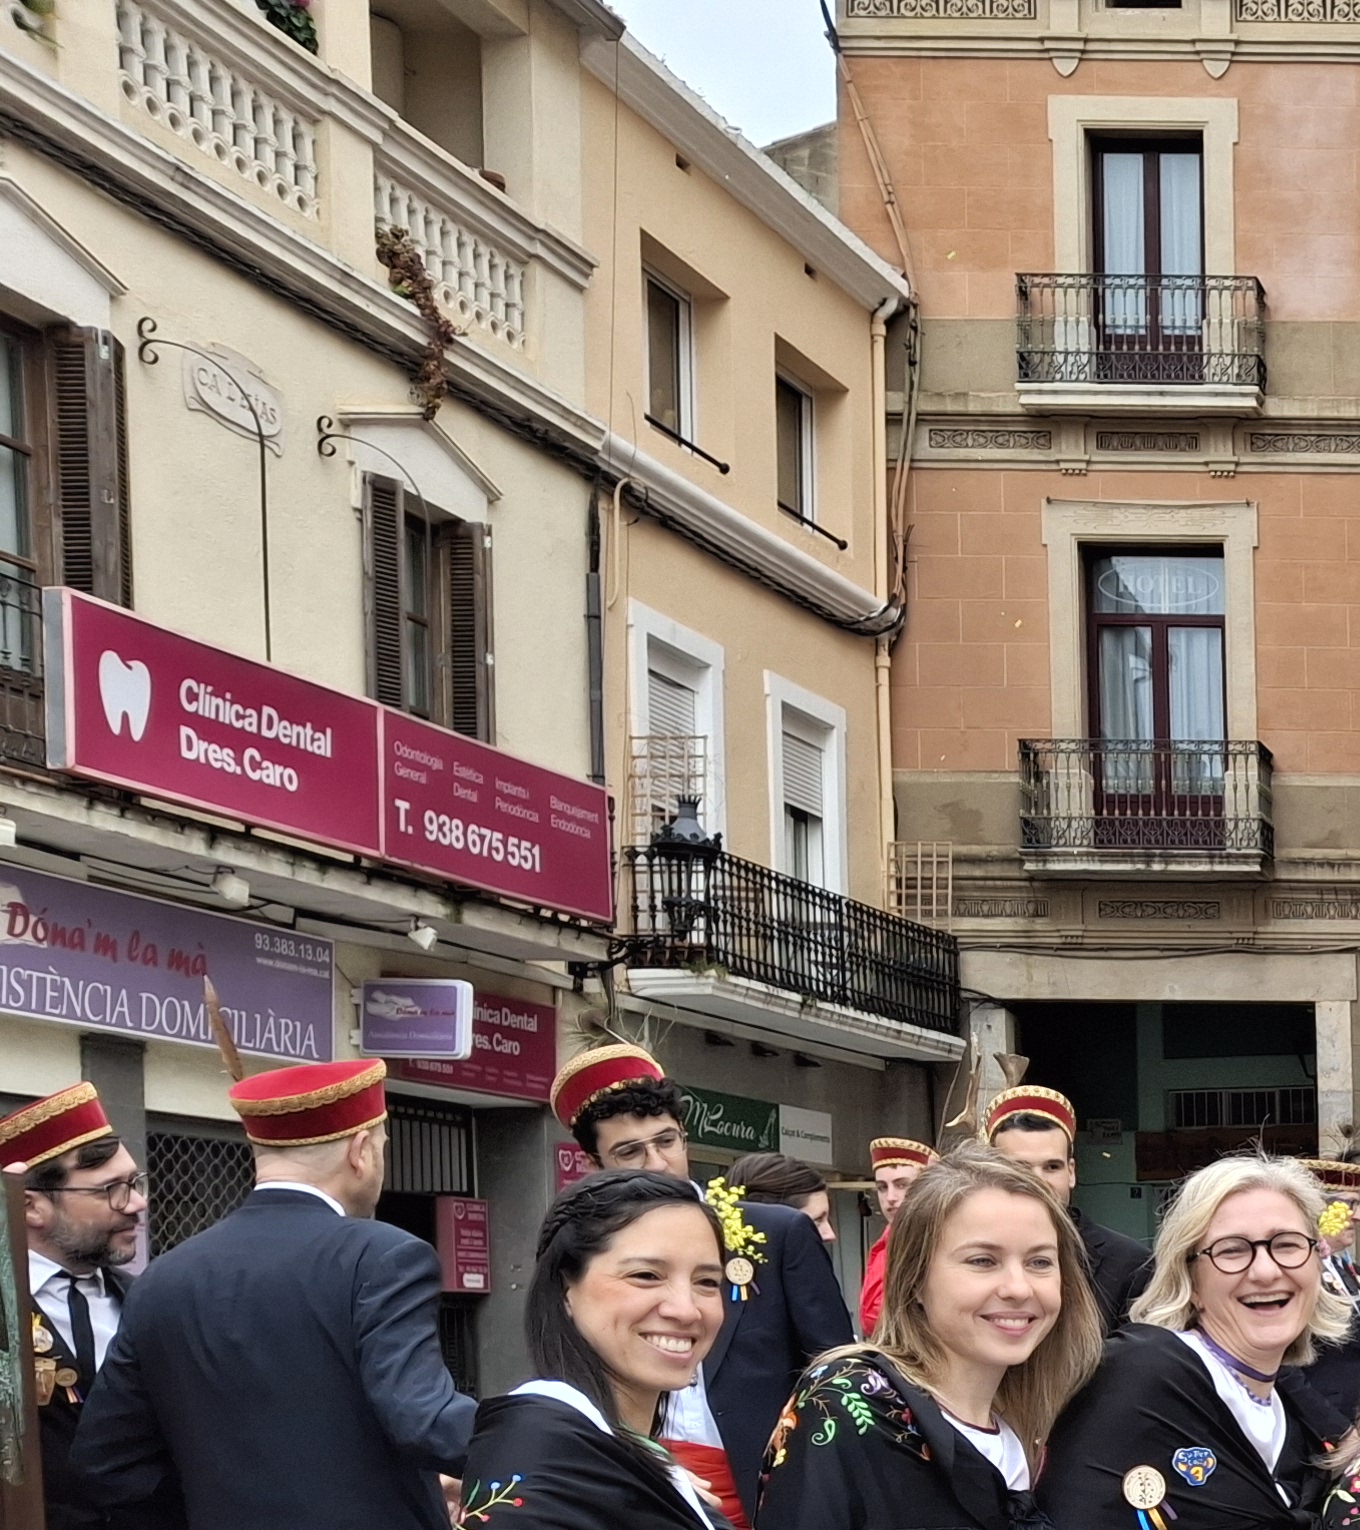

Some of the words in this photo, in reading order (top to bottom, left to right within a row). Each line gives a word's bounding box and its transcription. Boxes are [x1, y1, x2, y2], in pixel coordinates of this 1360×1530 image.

[179, 677, 258, 734] Clínica
[261, 704, 332, 758] Dental
[179, 724, 242, 775] Dres.
[243, 747, 299, 792] Caro
[394, 760, 427, 784] General
[453, 781, 478, 803] Dental
[394, 798, 414, 835] T.
[424, 809, 464, 850] 938
[467, 823, 505, 862] 675
[507, 835, 541, 873] 551
[128, 929, 159, 968] la
[254, 932, 330, 964] 93.383.13.04
[501, 1006, 538, 1033] Dental
[492, 1032, 521, 1056] Caro
